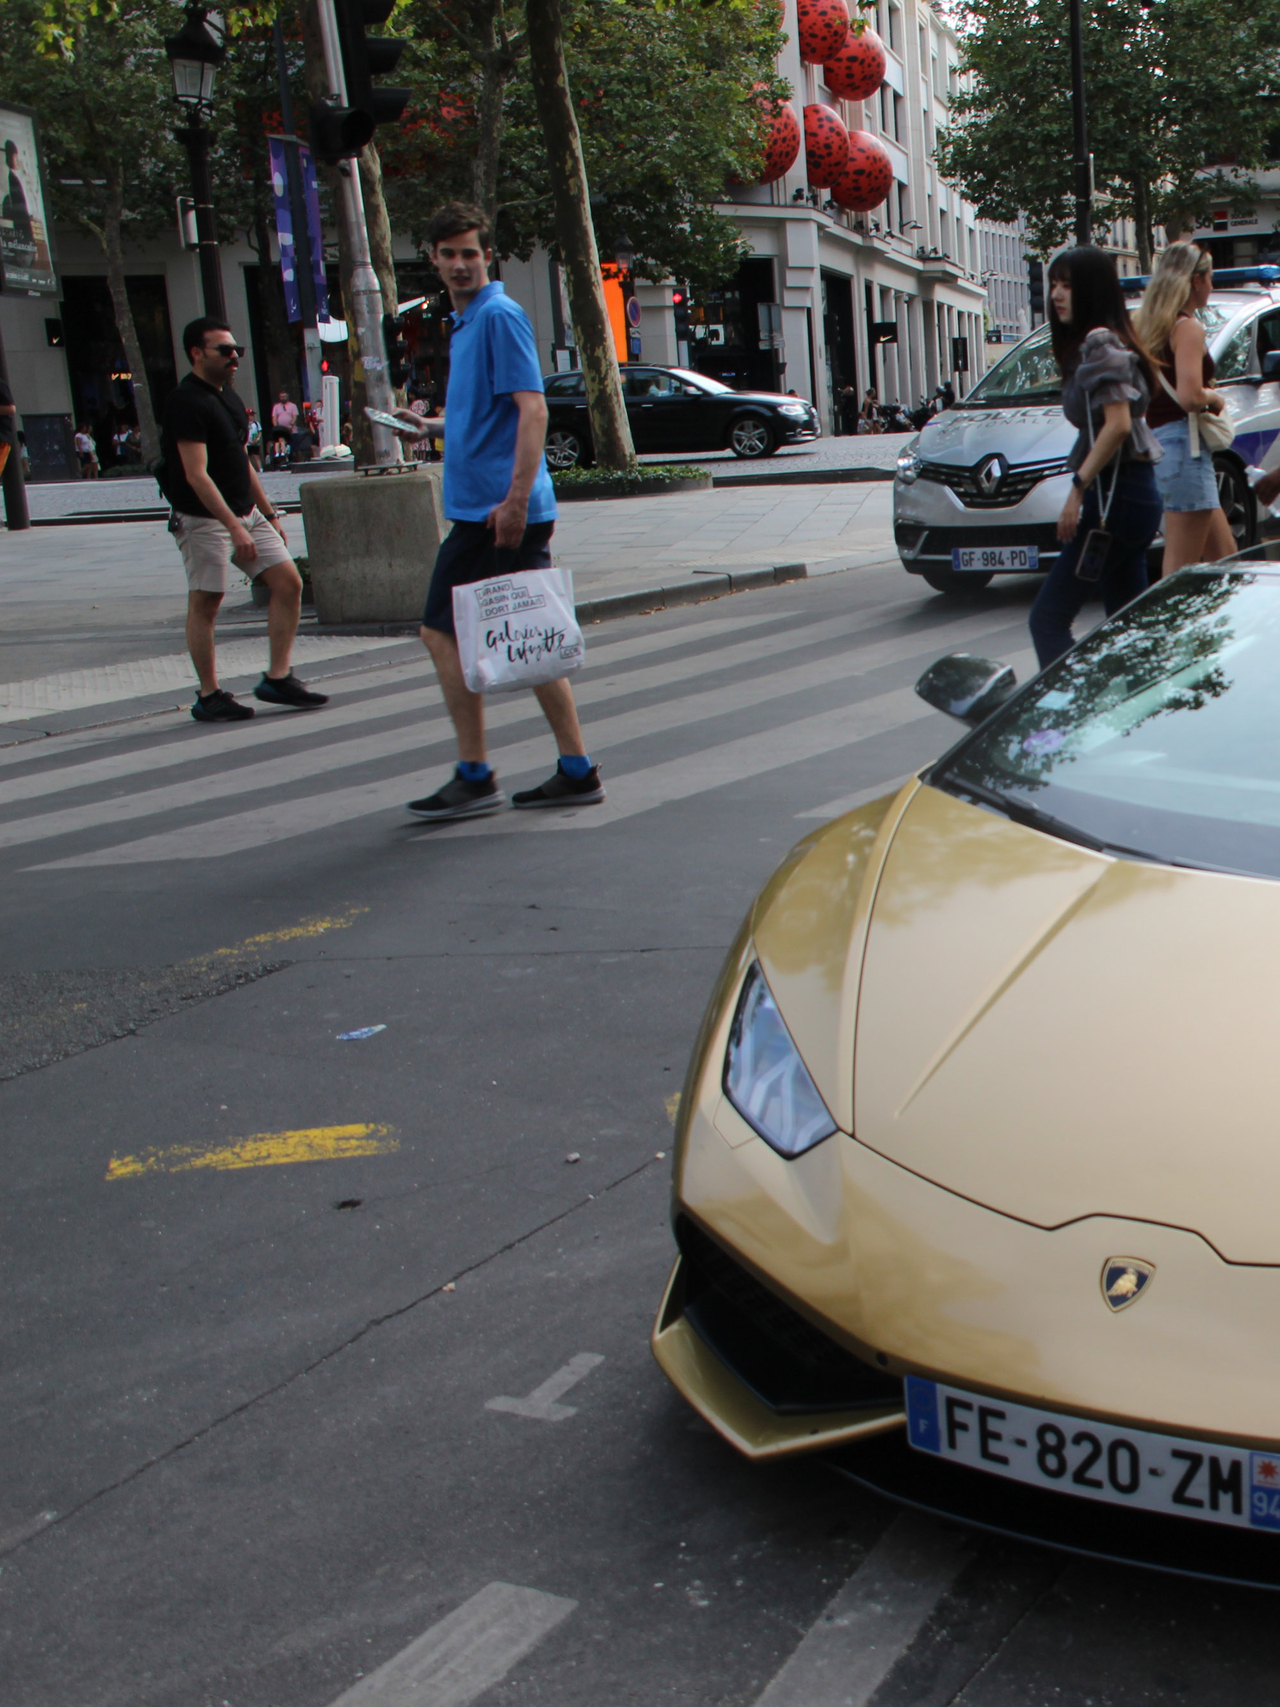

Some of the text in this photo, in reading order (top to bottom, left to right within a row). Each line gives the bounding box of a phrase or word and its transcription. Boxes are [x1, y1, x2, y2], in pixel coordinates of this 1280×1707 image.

[948, 407, 1064, 427] POLICE
[961, 549, 1027, 568] GF-984-PD
[485, 604, 510, 617] DORT
[486, 620, 542, 652] Galeries
[945, 1395, 1243, 1515] FE-820-ZM
